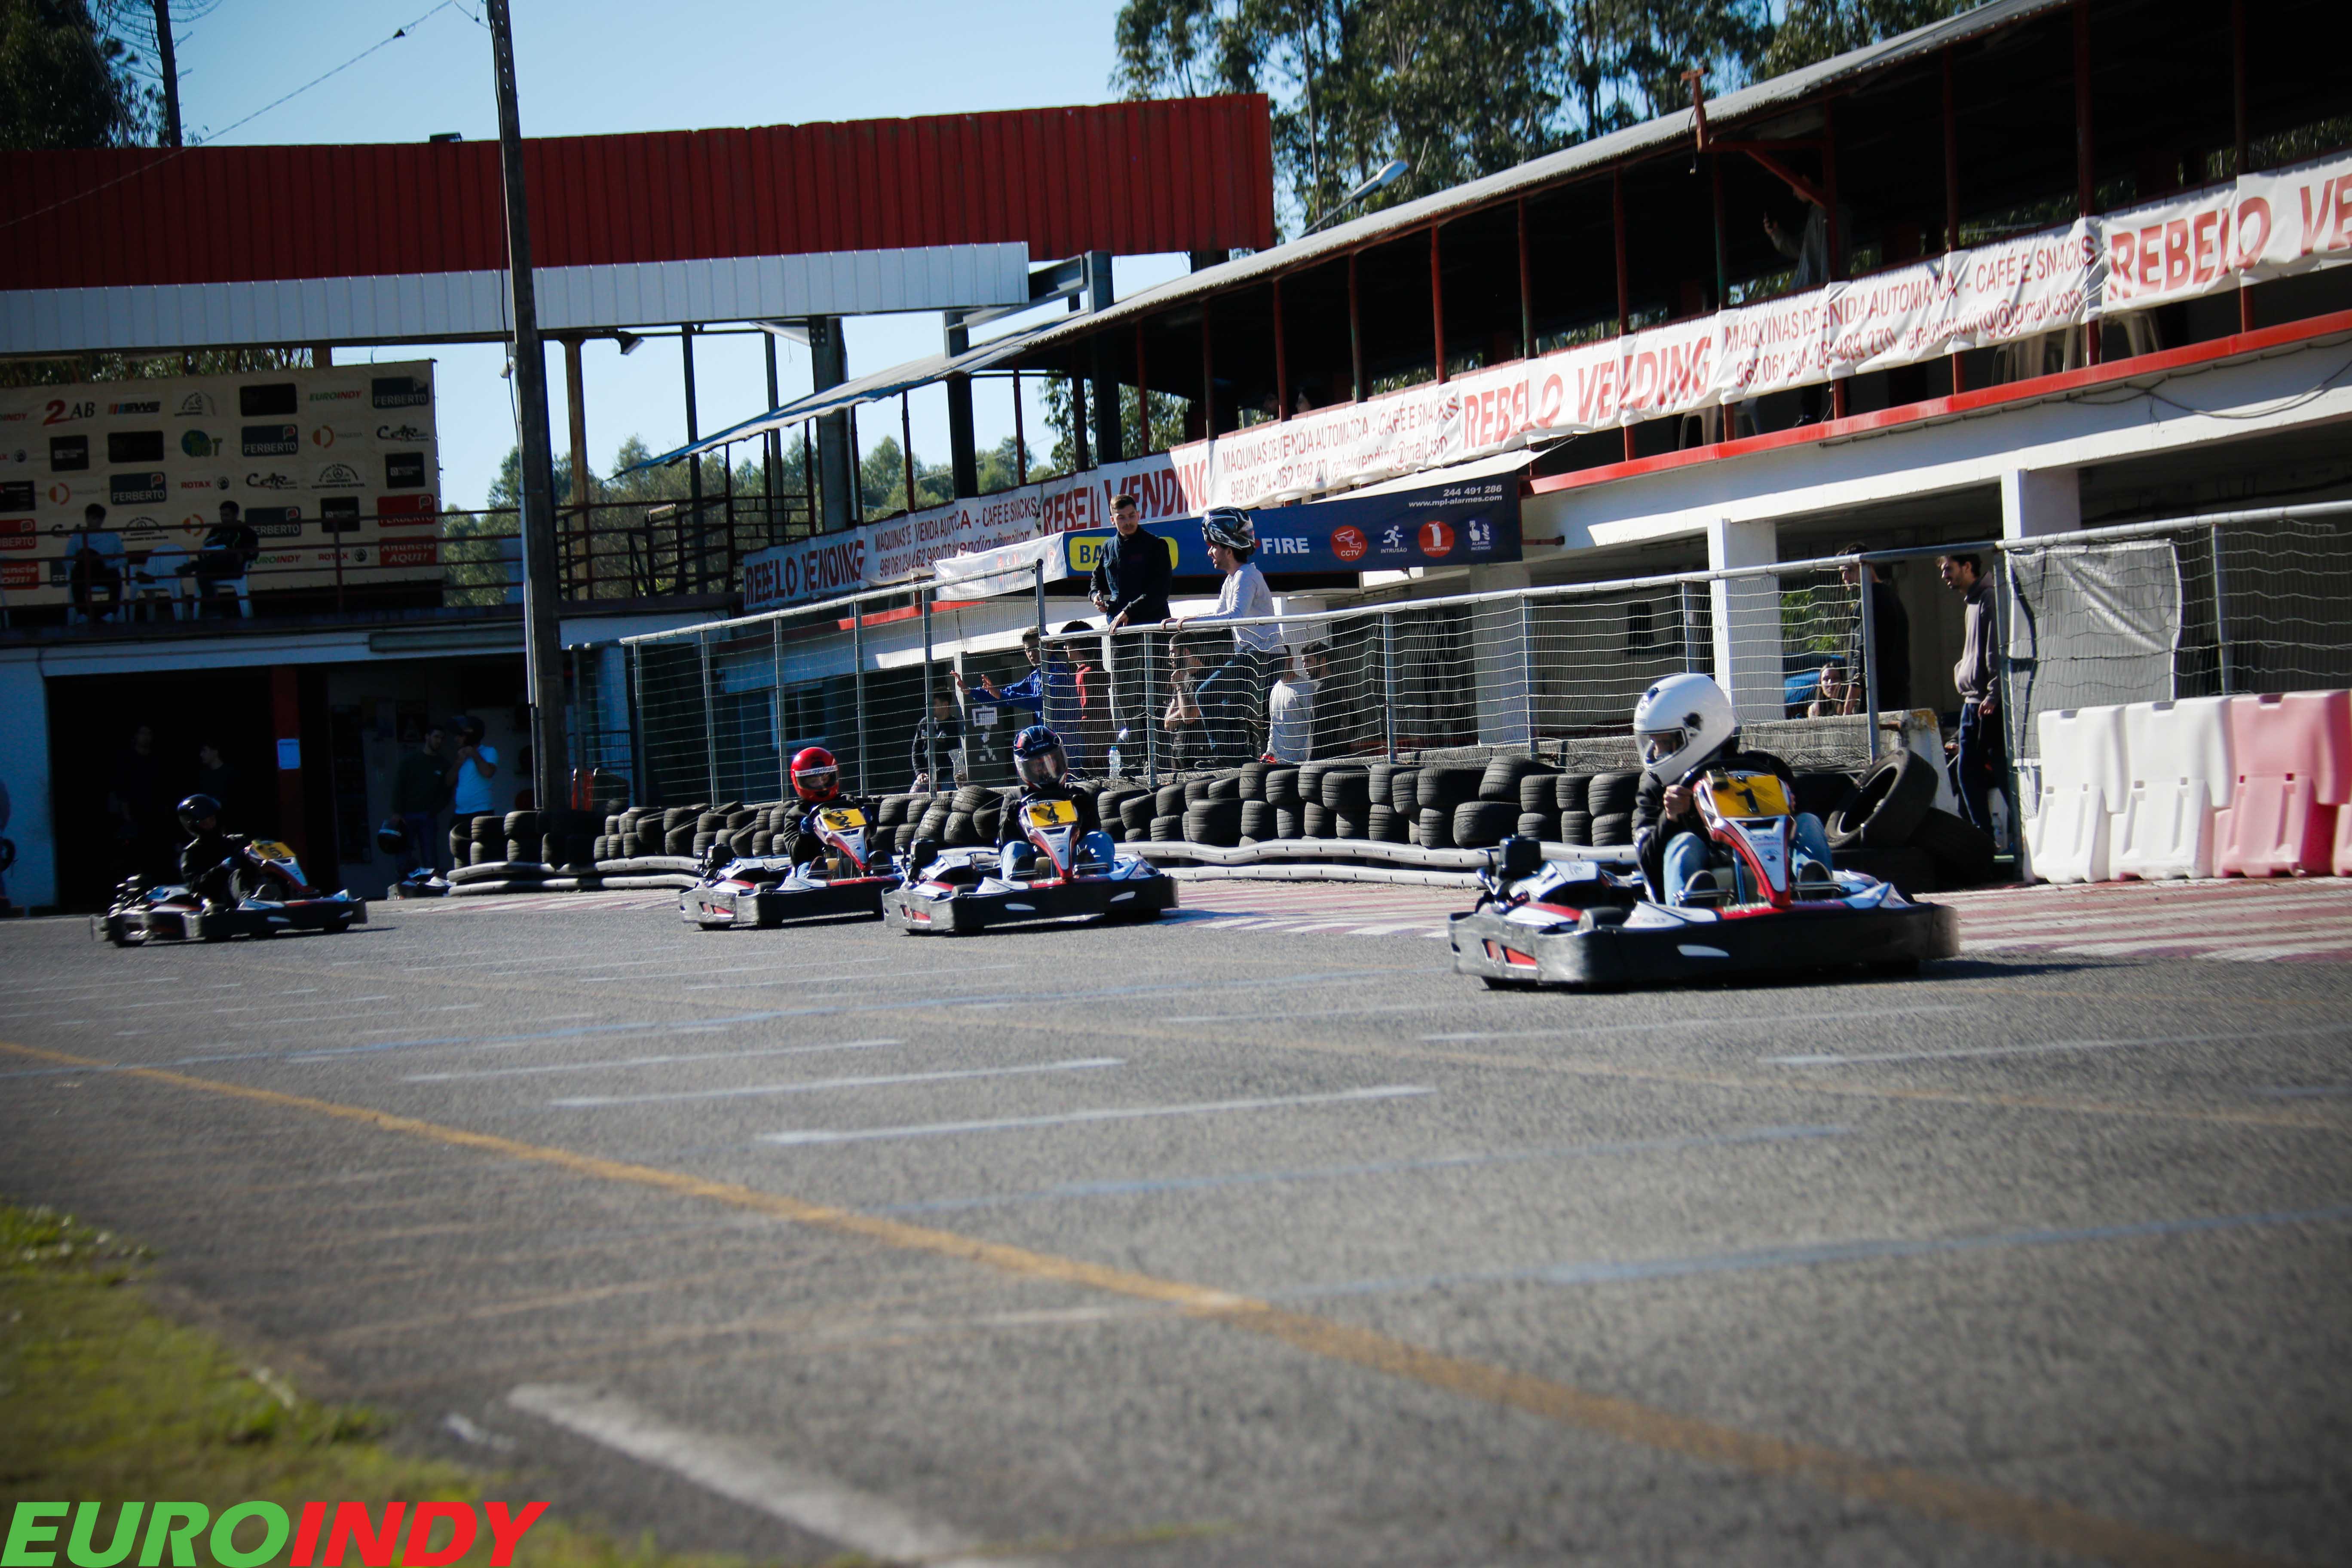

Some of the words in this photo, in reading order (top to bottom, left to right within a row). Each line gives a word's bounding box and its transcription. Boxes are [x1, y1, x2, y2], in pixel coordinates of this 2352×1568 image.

[2108, 197, 2271, 302] REBELO
[1725, 311, 1799, 352] MÁQUINAS
[1976, 248, 2015, 294] CAFÉ
[2021, 254, 2031, 283] E
[2037, 236, 2096, 280] SNACKS
[309, 390, 362, 401] EUROINDY
[374, 393, 427, 406] FERBERTO
[1464, 374, 1563, 450] REBELO
[1578, 337, 1712, 423] VENDING
[70, 401, 95, 418] AB
[1222, 444, 1267, 474] MÁQUINAS
[1269, 438, 1278, 462] DE
[1279, 429, 1314, 459] VENDA
[1409, 406, 1415, 429] E
[1418, 397, 1459, 427] SNACKS
[244, 442, 297, 454] FERBERTO
[1231, 479, 1244, 501] 969
[1246, 475, 1259, 499] 061
[1297, 462, 1313, 486] 989
[112, 490, 165, 502] FERBERTO
[1443, 488, 1461, 497] 244
[1464, 486, 1481, 496] 491
[1485, 484, 1502, 493] 286
[1409, 494, 1502, 508] www.mpl-alarmes.com
[875, 527, 906, 553] MÁQUINAS
[915, 520, 939, 542] VENDA
[983, 499, 1003, 527] CAFÉ
[1004, 506, 1009, 522] E
[1011, 496, 1037, 522] SNACKS
[1262, 537, 1309, 554] FIRE
[1380, 546, 1407, 554] INTRUSÃO
[389, 552, 428, 564] AQUI!
[746, 557, 797, 605] REBELO
[802, 540, 865, 593] VENDING
[1735, 788, 1760, 814] 1
[836, 815, 852, 827] 2
[1047, 805, 1059, 823] 4
